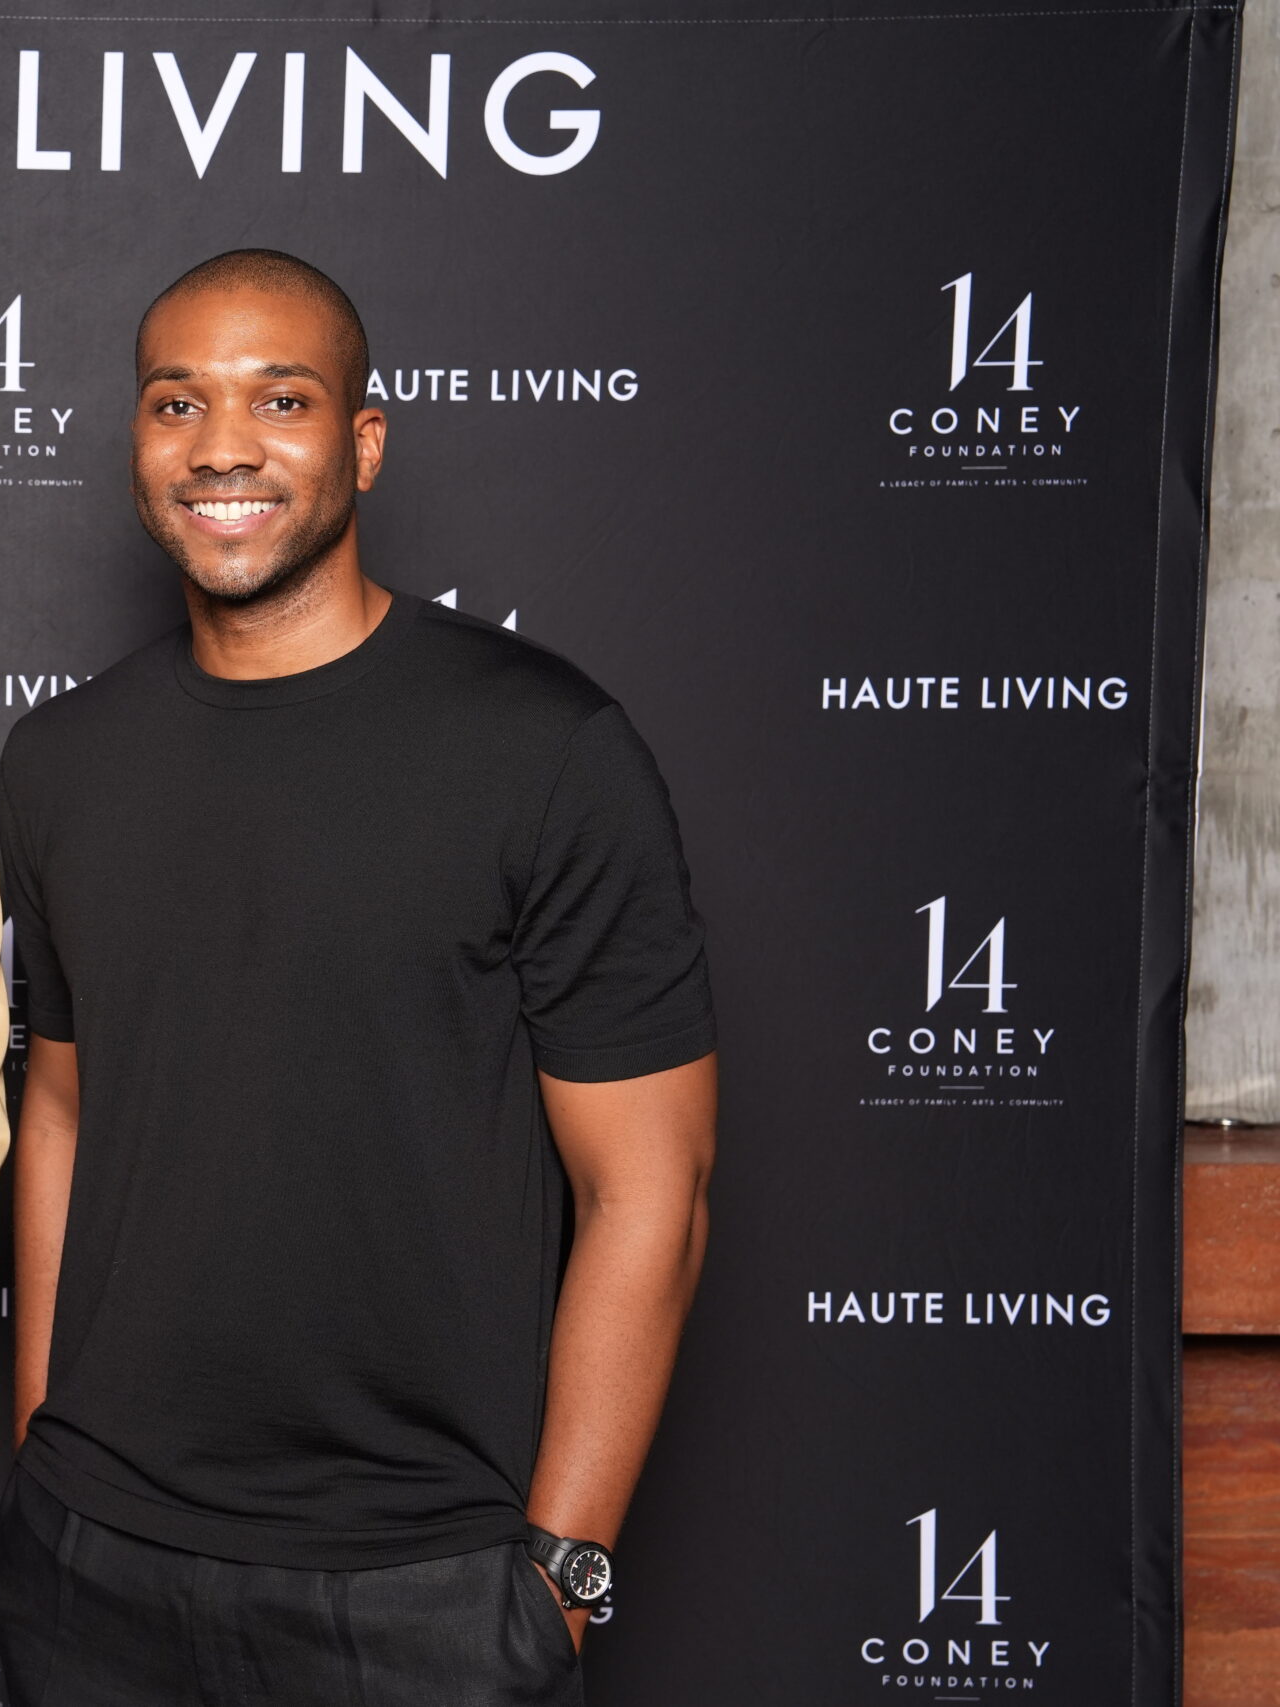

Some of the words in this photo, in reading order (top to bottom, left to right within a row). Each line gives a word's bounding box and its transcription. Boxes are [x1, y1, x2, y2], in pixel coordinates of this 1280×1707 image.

[16, 45, 601, 180] LIVING
[940, 271, 1044, 392] 14
[365, 368, 469, 402] AUTE
[490, 368, 639, 403] LIVING
[888, 405, 1081, 436] CONEY
[908, 444, 1062, 458] FOUNDATION
[27, 479, 84, 487] COMMUNITY
[890, 480, 926, 488] LEGACY
[994, 479, 1018, 487] ARTS
[1032, 478, 1088, 486] COMMUNITY
[821, 676, 960, 710] HAUTE
[981, 676, 1128, 710] LIVING
[914, 895, 1018, 1014] 14
[867, 1027, 1055, 1055] CONEY
[887, 1064, 1038, 1078] FOUNDATION
[869, 1098, 905, 1106] LEGACY
[908, 1098, 921, 1106] OF
[972, 1099, 995, 1107] ARTS
[1008, 1099, 1064, 1107] COMMUNITY
[807, 1290, 944, 1324] HAUTE
[965, 1292, 1111, 1327] LIVING
[905, 1507, 1012, 1626] 14
[860, 1637, 1050, 1668] CONEY
[881, 1674, 1034, 1689] FOUNDATION
